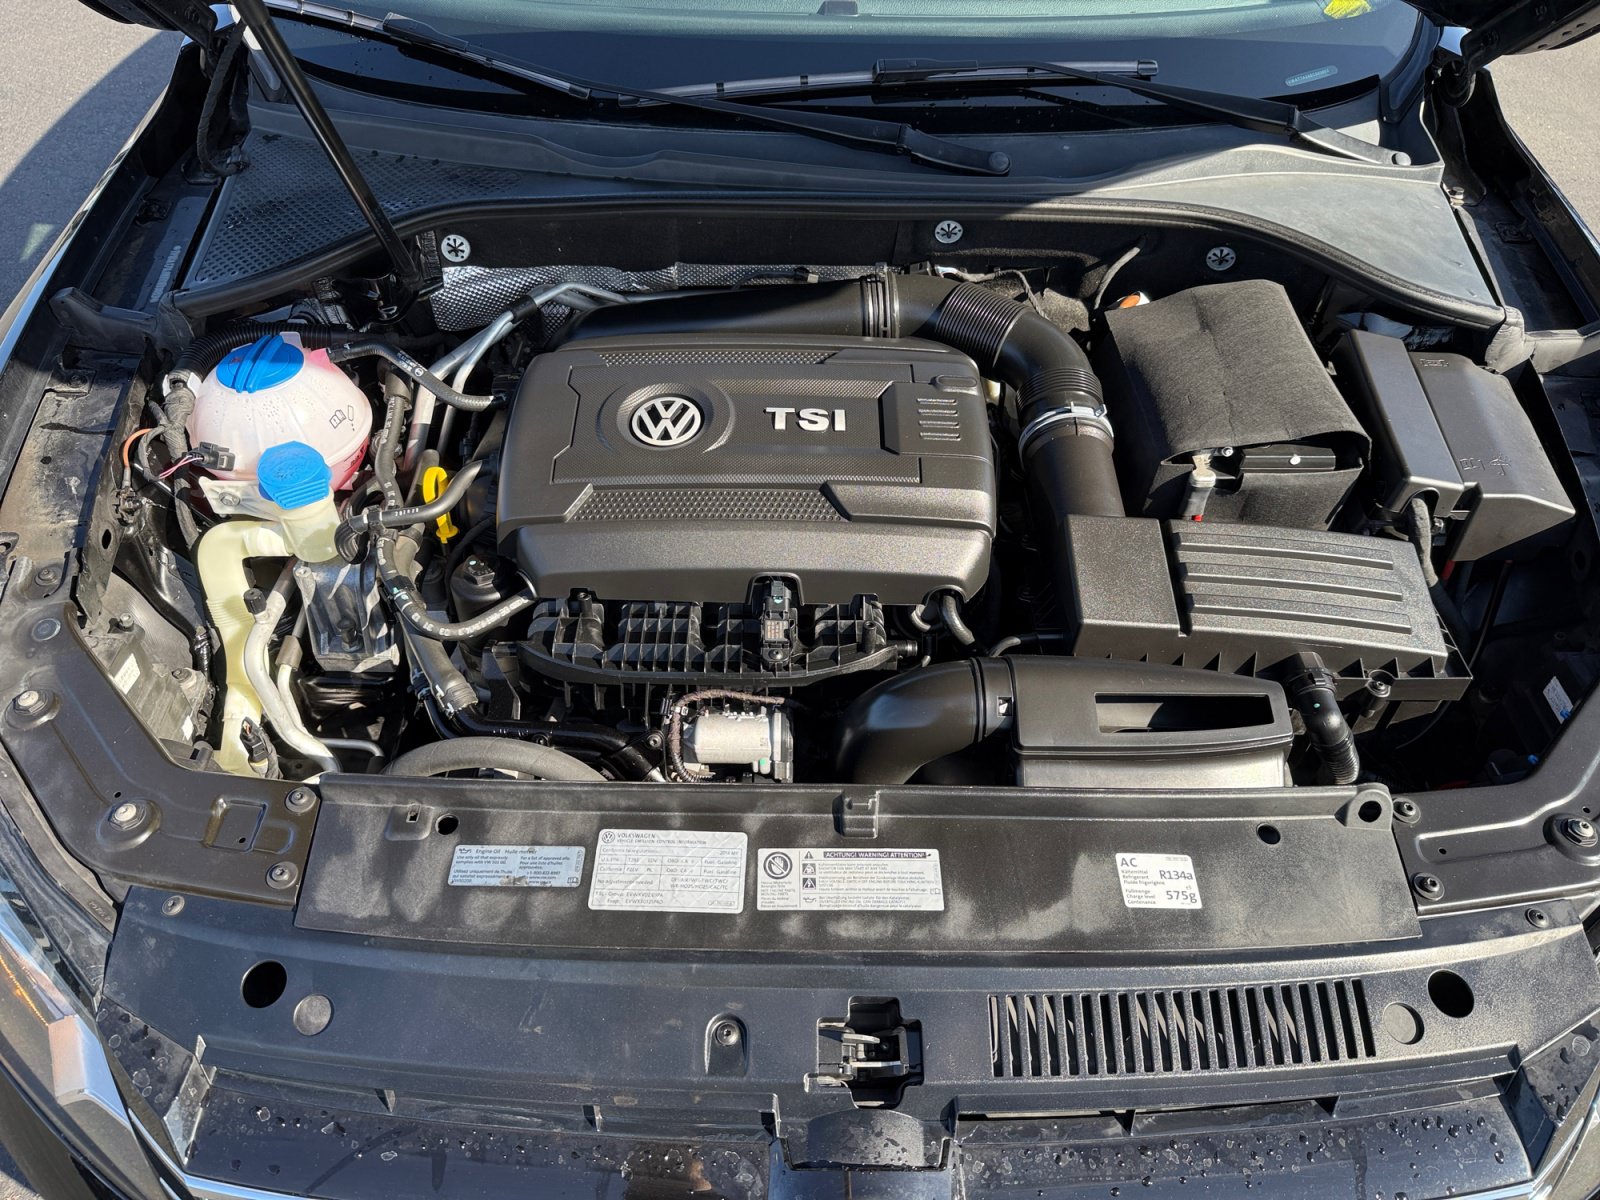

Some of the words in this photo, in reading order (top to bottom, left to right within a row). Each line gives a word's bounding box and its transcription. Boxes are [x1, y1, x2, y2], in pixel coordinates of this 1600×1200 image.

[765, 407, 846, 432] TSI
[1120, 857, 1138, 868] AC
[1158, 869, 1194, 881] R134a
